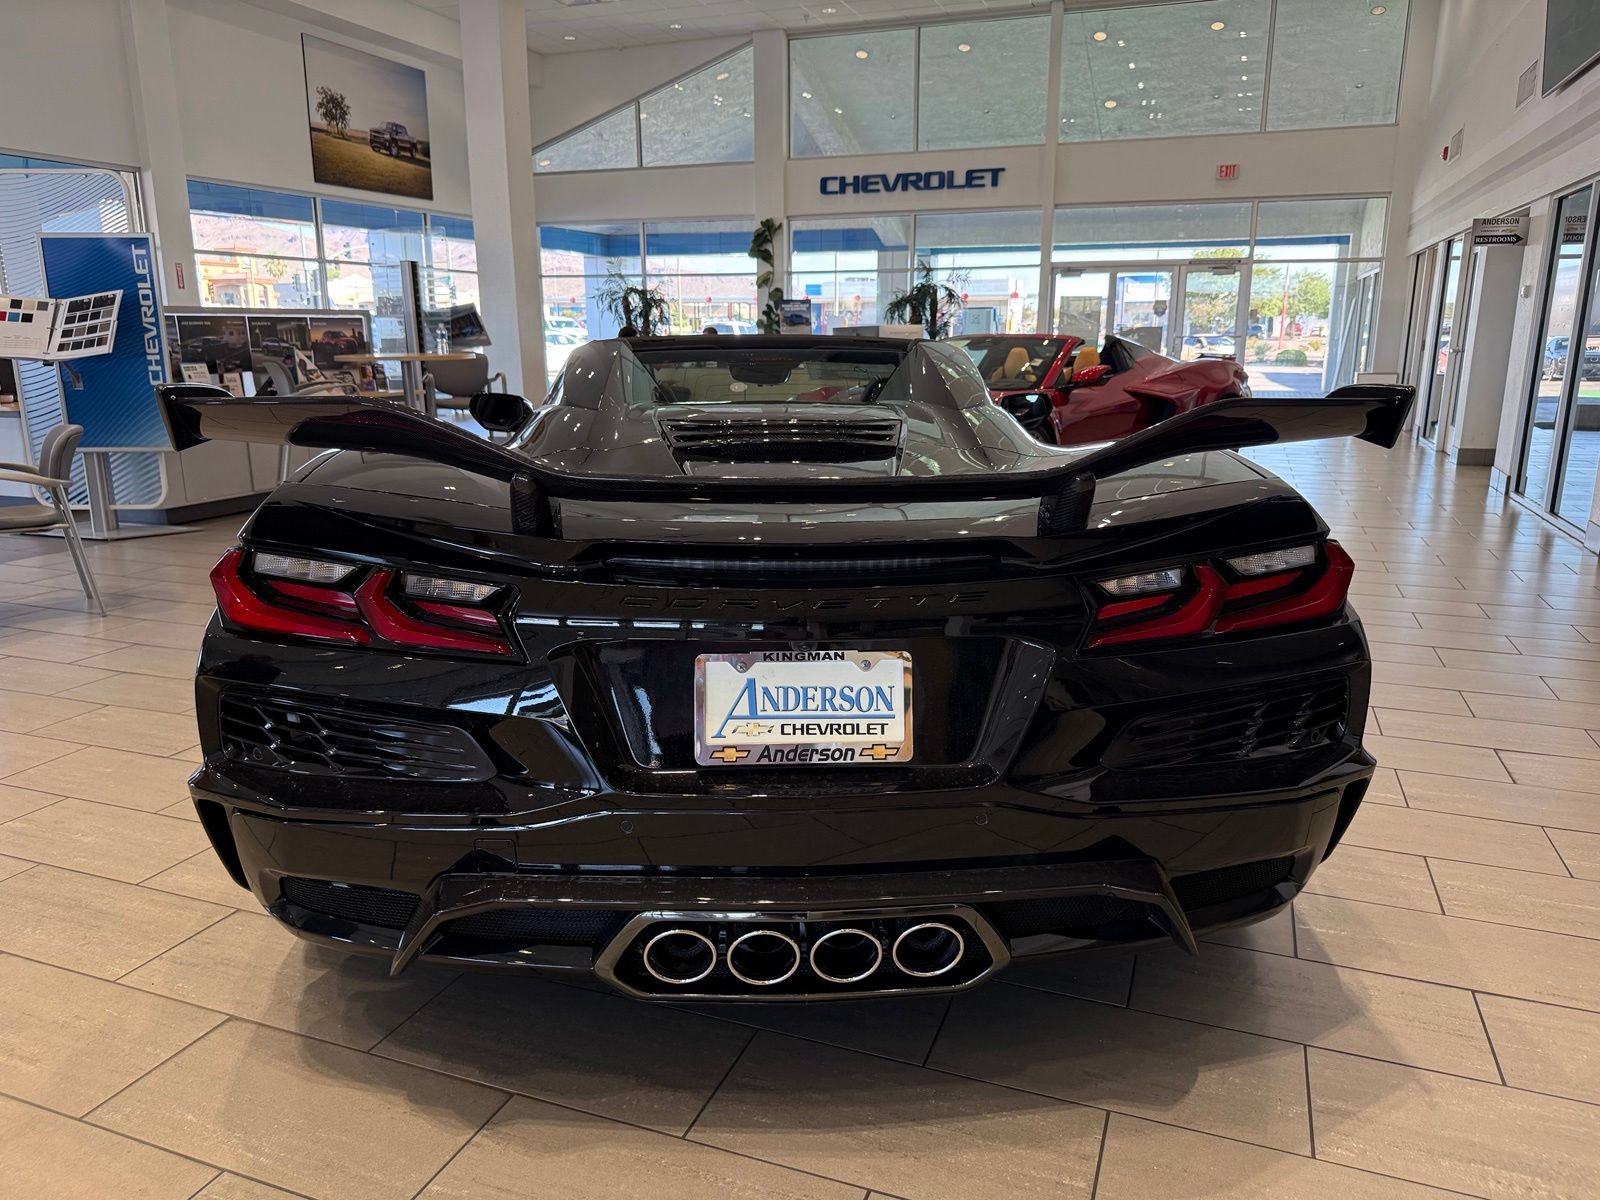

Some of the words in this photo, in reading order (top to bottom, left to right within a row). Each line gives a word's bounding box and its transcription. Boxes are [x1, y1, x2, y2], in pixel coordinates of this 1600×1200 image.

[1219, 164, 1237, 178] EXIT
[820, 168, 1006, 195] CHEVROLET
[1481, 217, 1520, 226] ANDERSON
[131, 244, 164, 386] CHEVROLET
[619, 590, 989, 611] CORVETTE
[763, 651, 845, 662] KINGMAN
[711, 677, 895, 738] ANDERSON
[780, 723, 889, 736] CHEVROLET
[756, 745, 855, 763] Anderson
